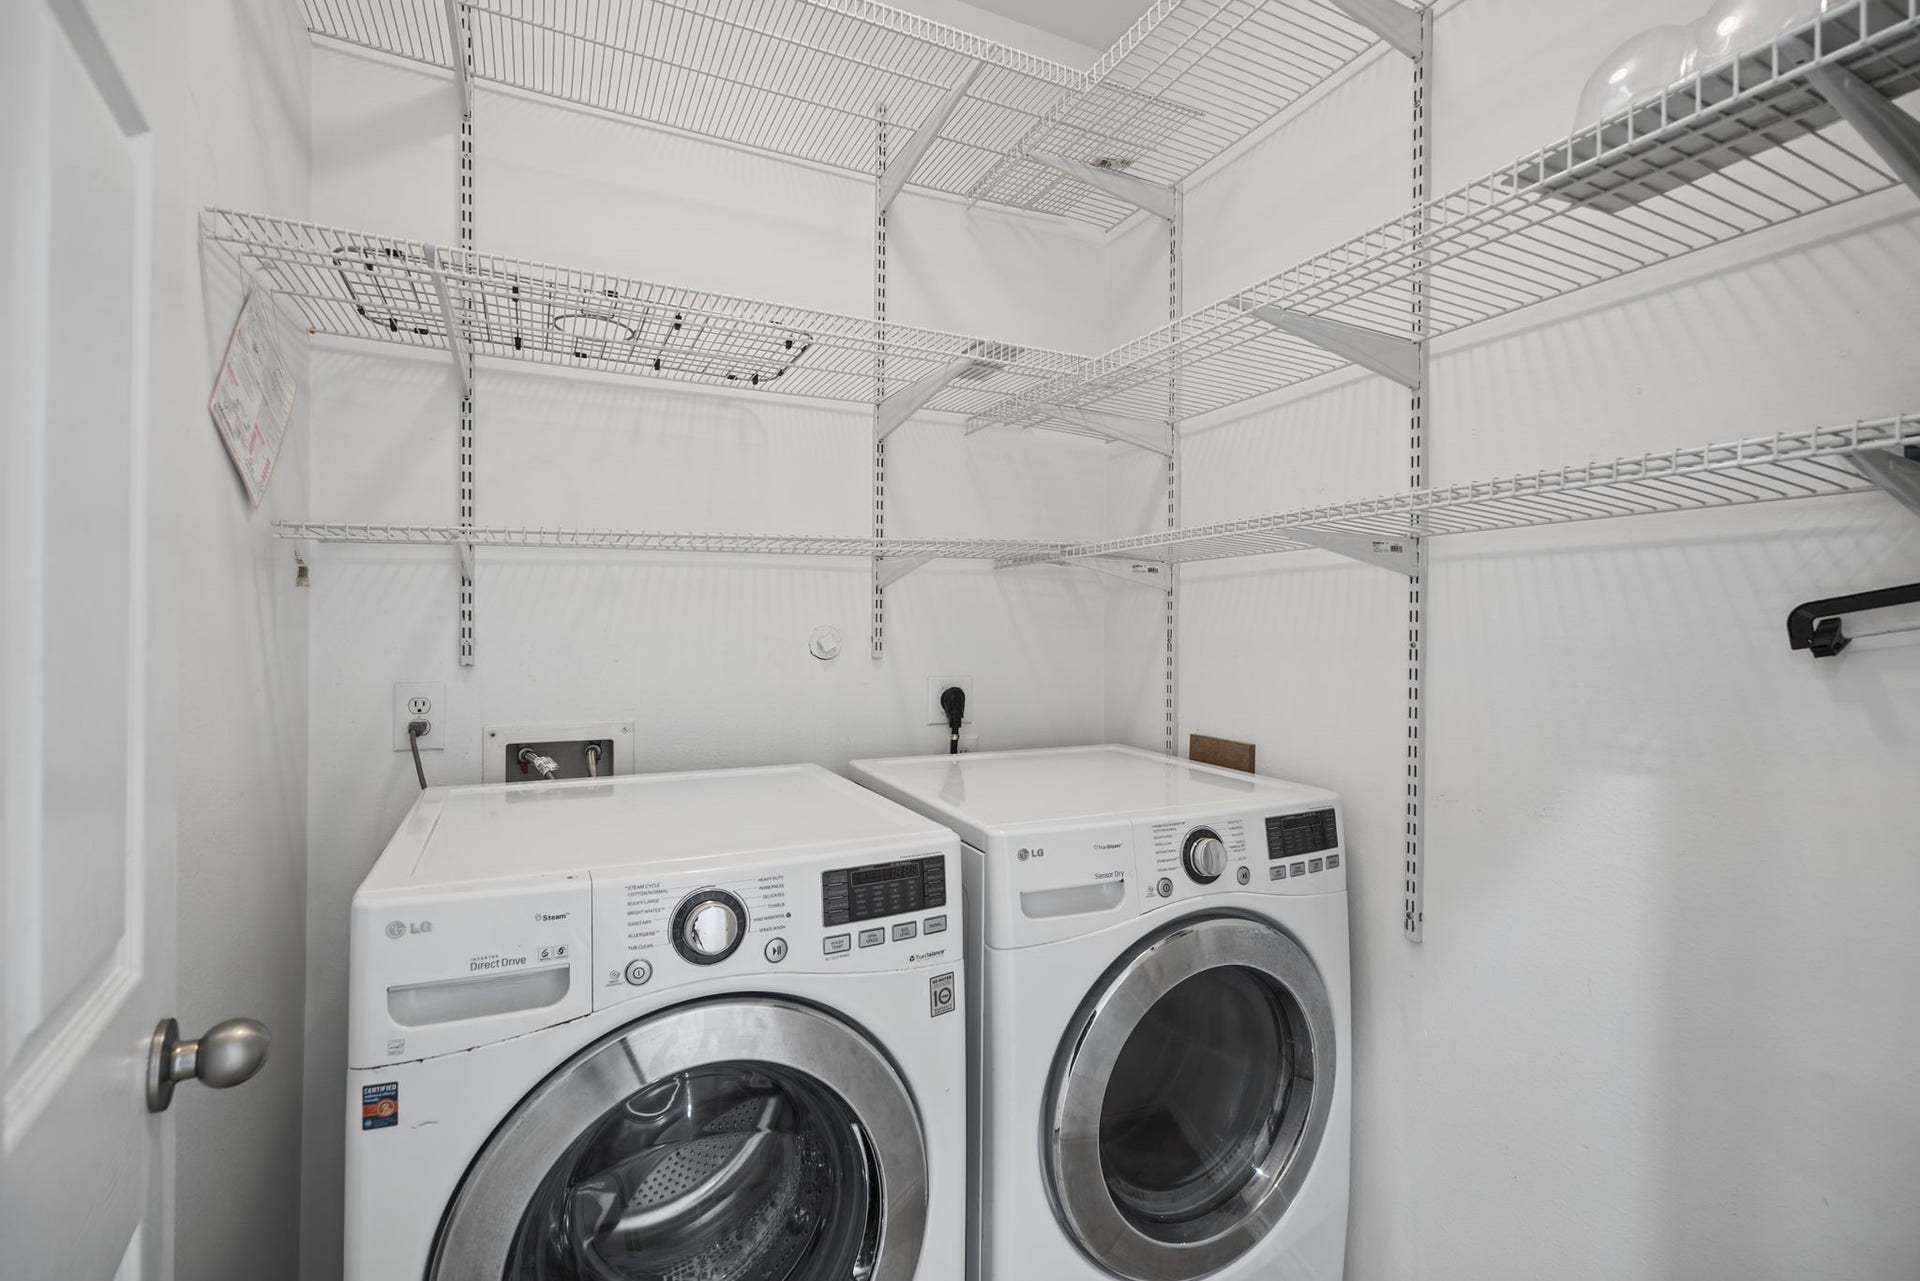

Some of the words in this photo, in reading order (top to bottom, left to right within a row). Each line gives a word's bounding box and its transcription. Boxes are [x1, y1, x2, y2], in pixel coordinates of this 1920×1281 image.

[1031, 848, 1044, 857] LG
[1095, 872, 1113, 880] Sensor
[1114, 870, 1124, 878] Dry
[410, 920, 432, 934] LG
[470, 959, 500, 972] Direct
[501, 956, 527, 967] Drive
